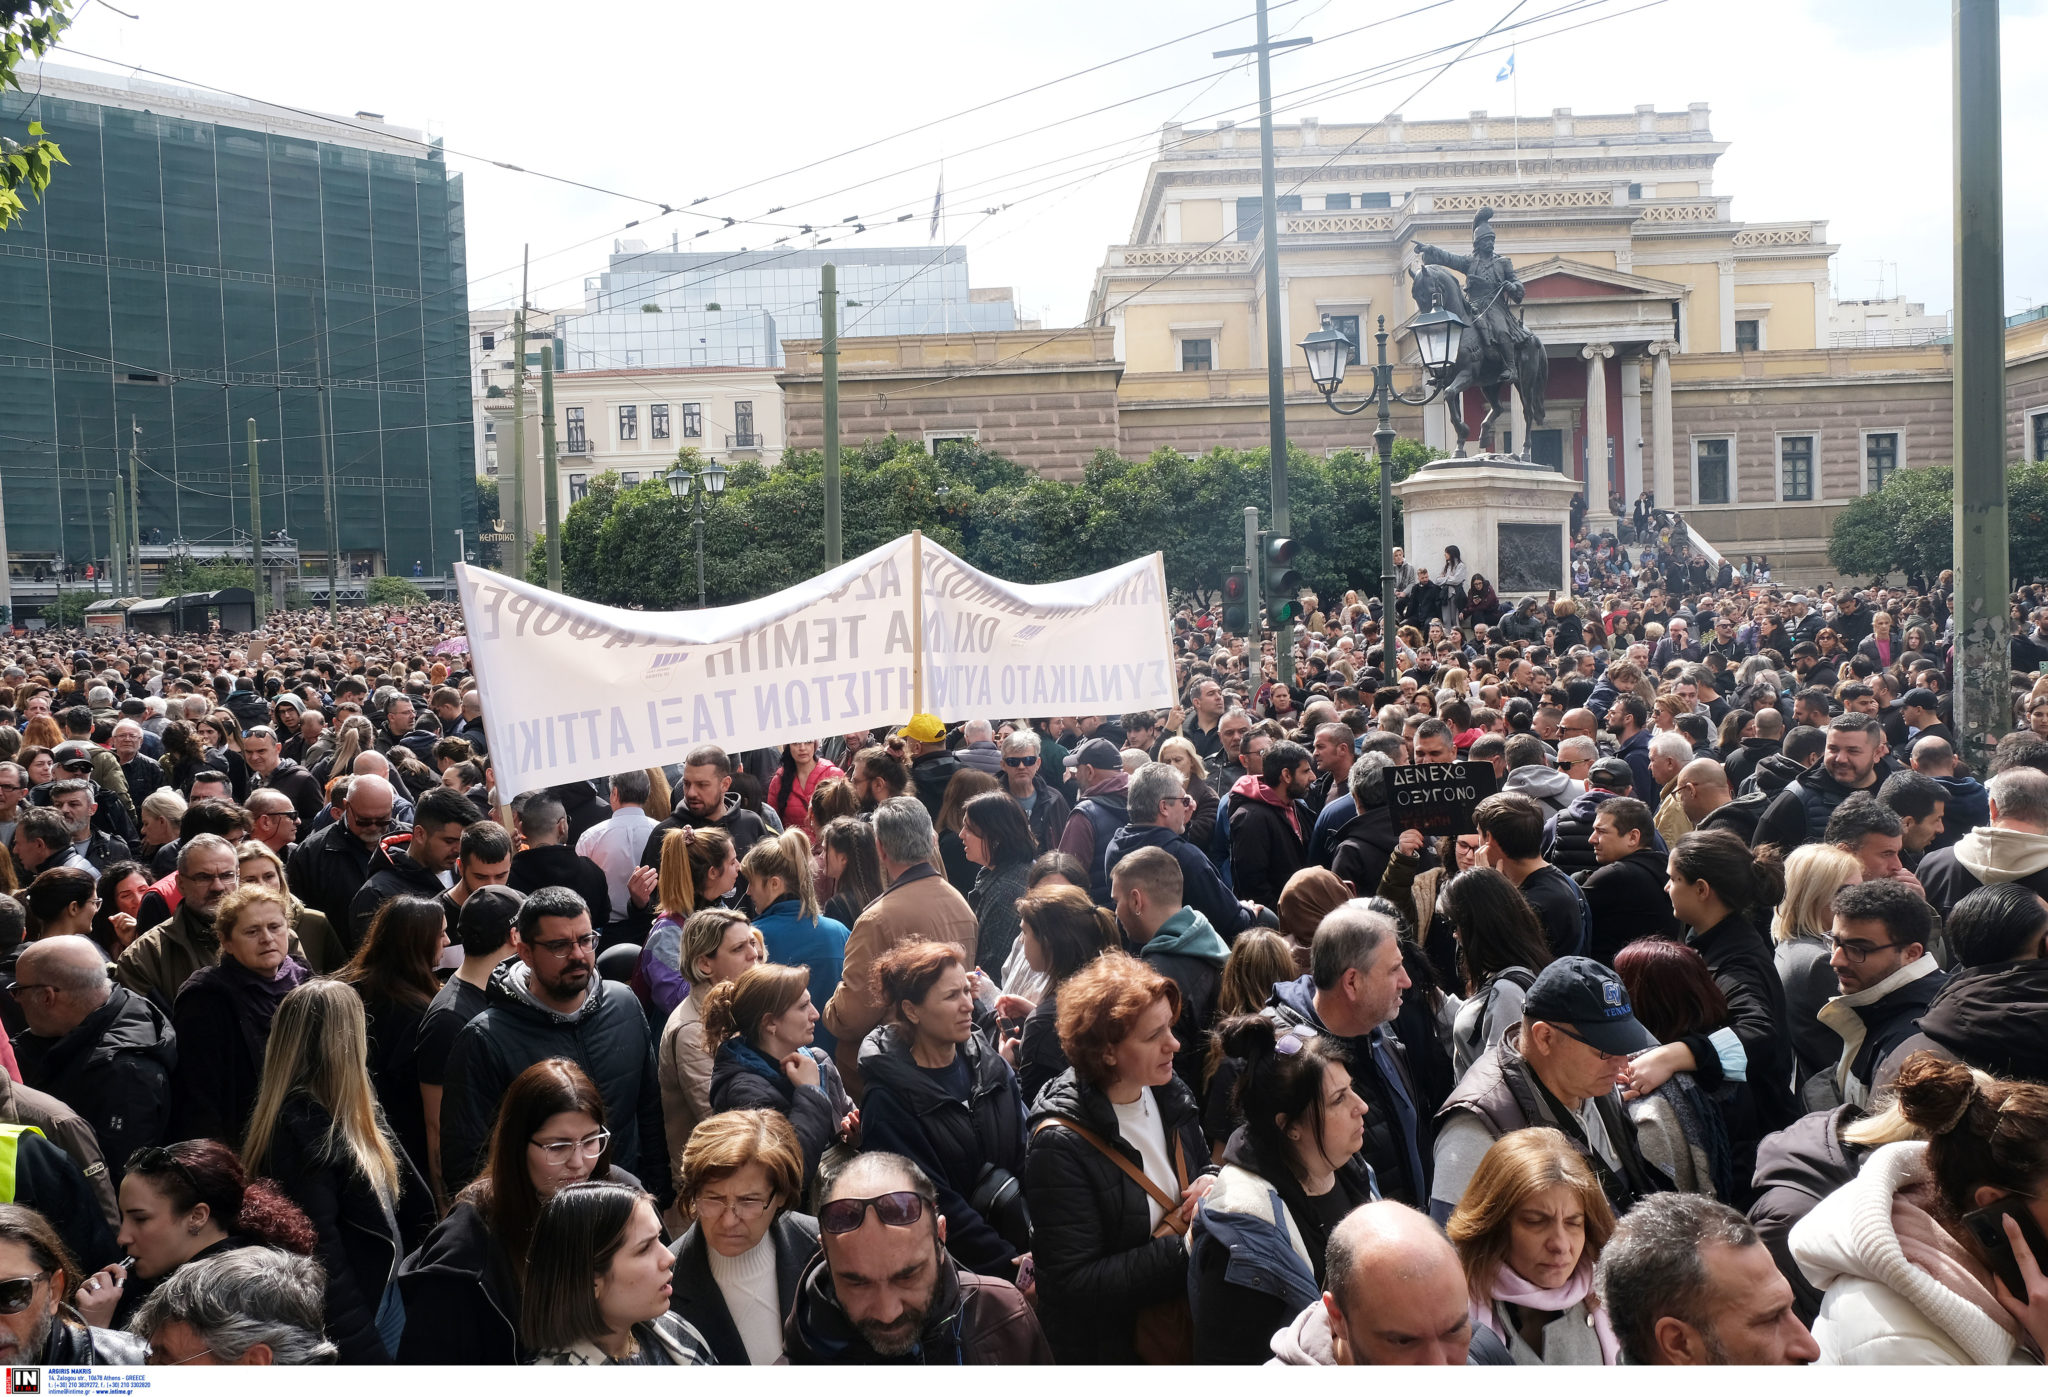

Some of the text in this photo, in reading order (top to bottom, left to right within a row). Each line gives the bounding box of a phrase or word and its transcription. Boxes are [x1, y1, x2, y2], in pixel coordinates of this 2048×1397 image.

[1394, 764, 1466, 786] ΔΕΝ ΕΧΩ
[1397, 785, 1476, 806] ΟΞΥΓΟΝΟ
